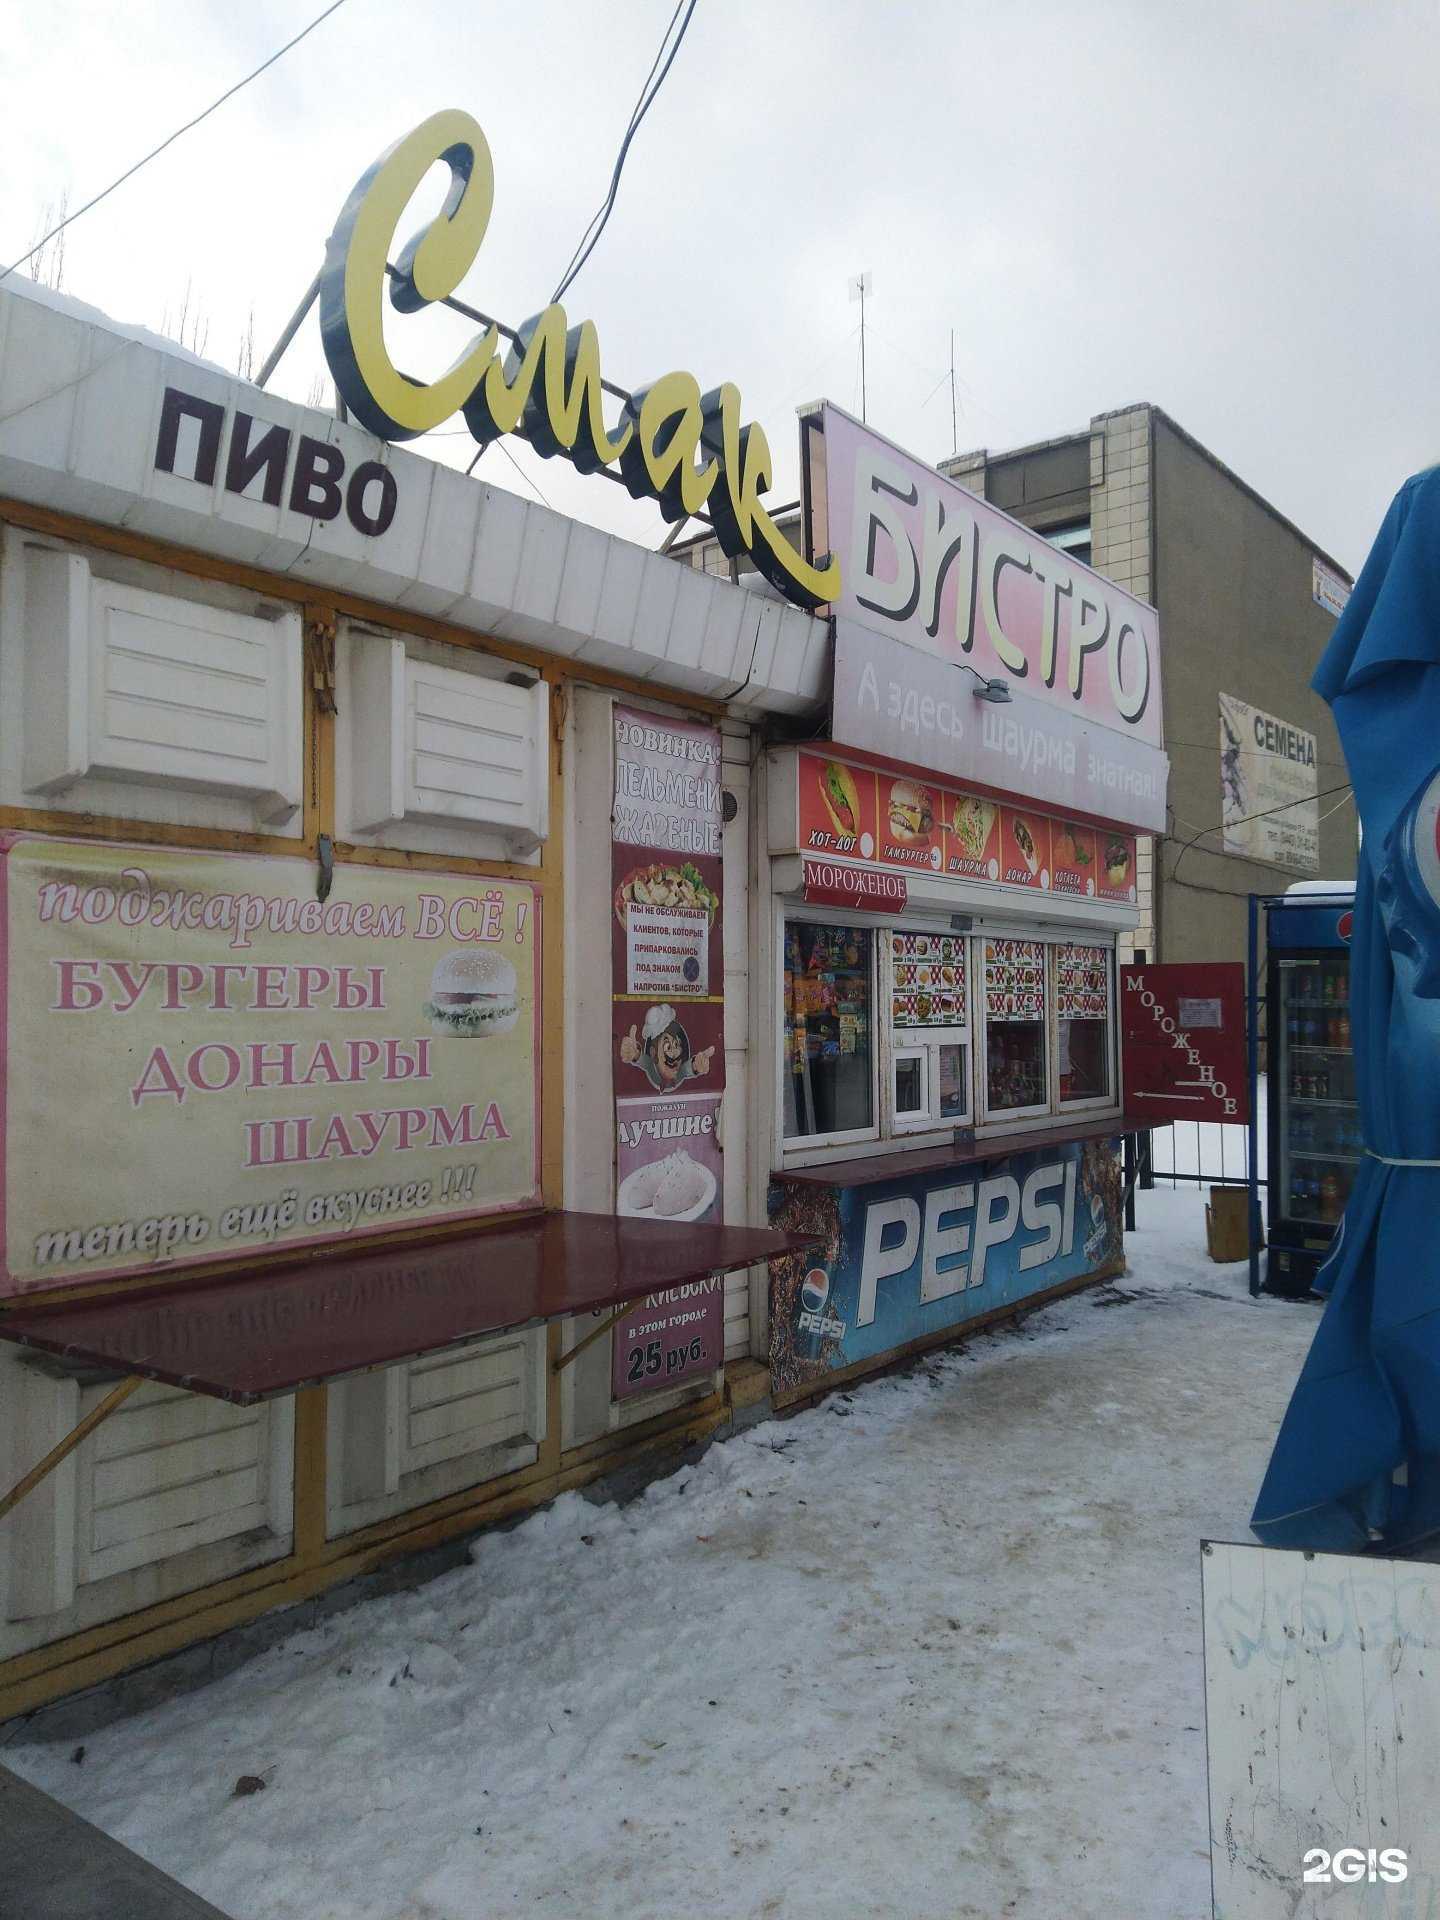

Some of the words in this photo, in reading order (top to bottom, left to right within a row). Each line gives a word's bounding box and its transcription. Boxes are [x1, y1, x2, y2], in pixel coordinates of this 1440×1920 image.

[322, 108, 842, 606] Смак
[155, 386, 398, 536] ПИВО
[852, 444, 1150, 724] БИСТРО
[857, 662, 880, 712] А
[888, 682, 964, 739] здесь
[1254, 715, 1316, 769] СЕМЕНА
[616, 758, 723, 814] ПЕЛЬМЕНИ
[615, 805, 720, 855] ЖАРЕНЫЕ
[808, 829, 857, 852] ХОТ-ДОГ
[883, 845, 929, 864] ГАМБУРГЕР
[807, 863, 906, 898] МОРОЖЕНОЕ
[948, 856, 988, 876] ШАУРМА
[39, 869, 404, 948] поджариваем
[630, 904, 644, 914] МЫ
[645, 906, 655, 915] НЕ
[656, 907, 706, 920] ОБСЛУЖИВАЕМ
[672, 927, 704, 938] КОТОРЫЕ
[634, 943, 698, 956] ПРИПАРКОВАЛИСЬ
[636, 963, 652, 974] ПОД
[652, 964, 681, 974] ЗНАКОМ
[50, 961, 386, 1012] БУРГЕРЫ
[633, 982, 670, 992] НАПРОТИВ
[1126, 975, 1238, 1115] МОРОЖЕНОЕ
[131, 1038, 433, 1107] ДОНАРЫ
[243, 1102, 511, 1167] ШАУРМА
[34, 1218, 209, 1268] теперь
[219, 1191, 298, 1239] ещё
[856, 1160, 1077, 1329] PEPSI
[638, 1319, 667, 1336] этом
[669, 1308, 707, 1327] городе
[799, 1312, 847, 1340] PEPSI
[627, 1339, 663, 1384] 25
[665, 1336, 707, 1376] руб.
